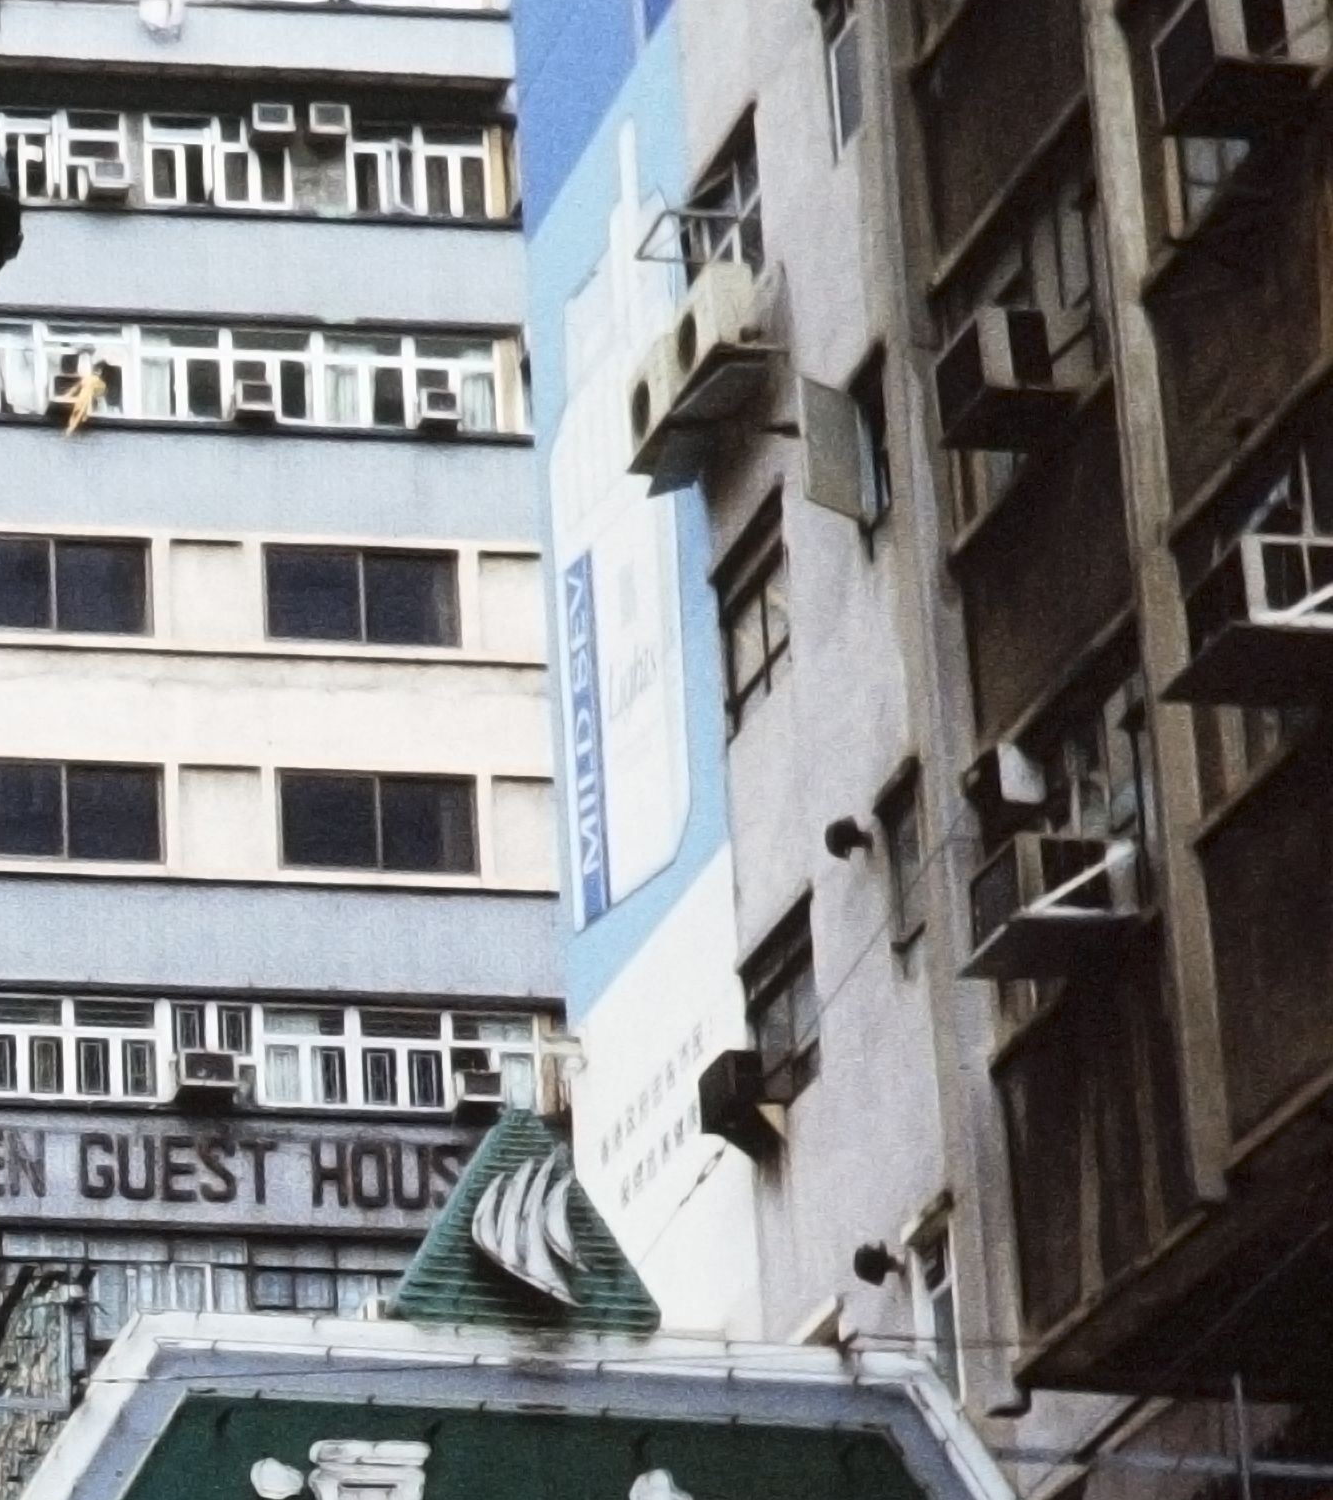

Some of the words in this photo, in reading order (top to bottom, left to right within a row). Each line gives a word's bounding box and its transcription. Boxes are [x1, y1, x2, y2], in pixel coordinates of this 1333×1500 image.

[574, 707, 599, 876] MILD
[78, 1132, 276, 1204] GUEST
[311, 1139, 473, 1210] HOUS
